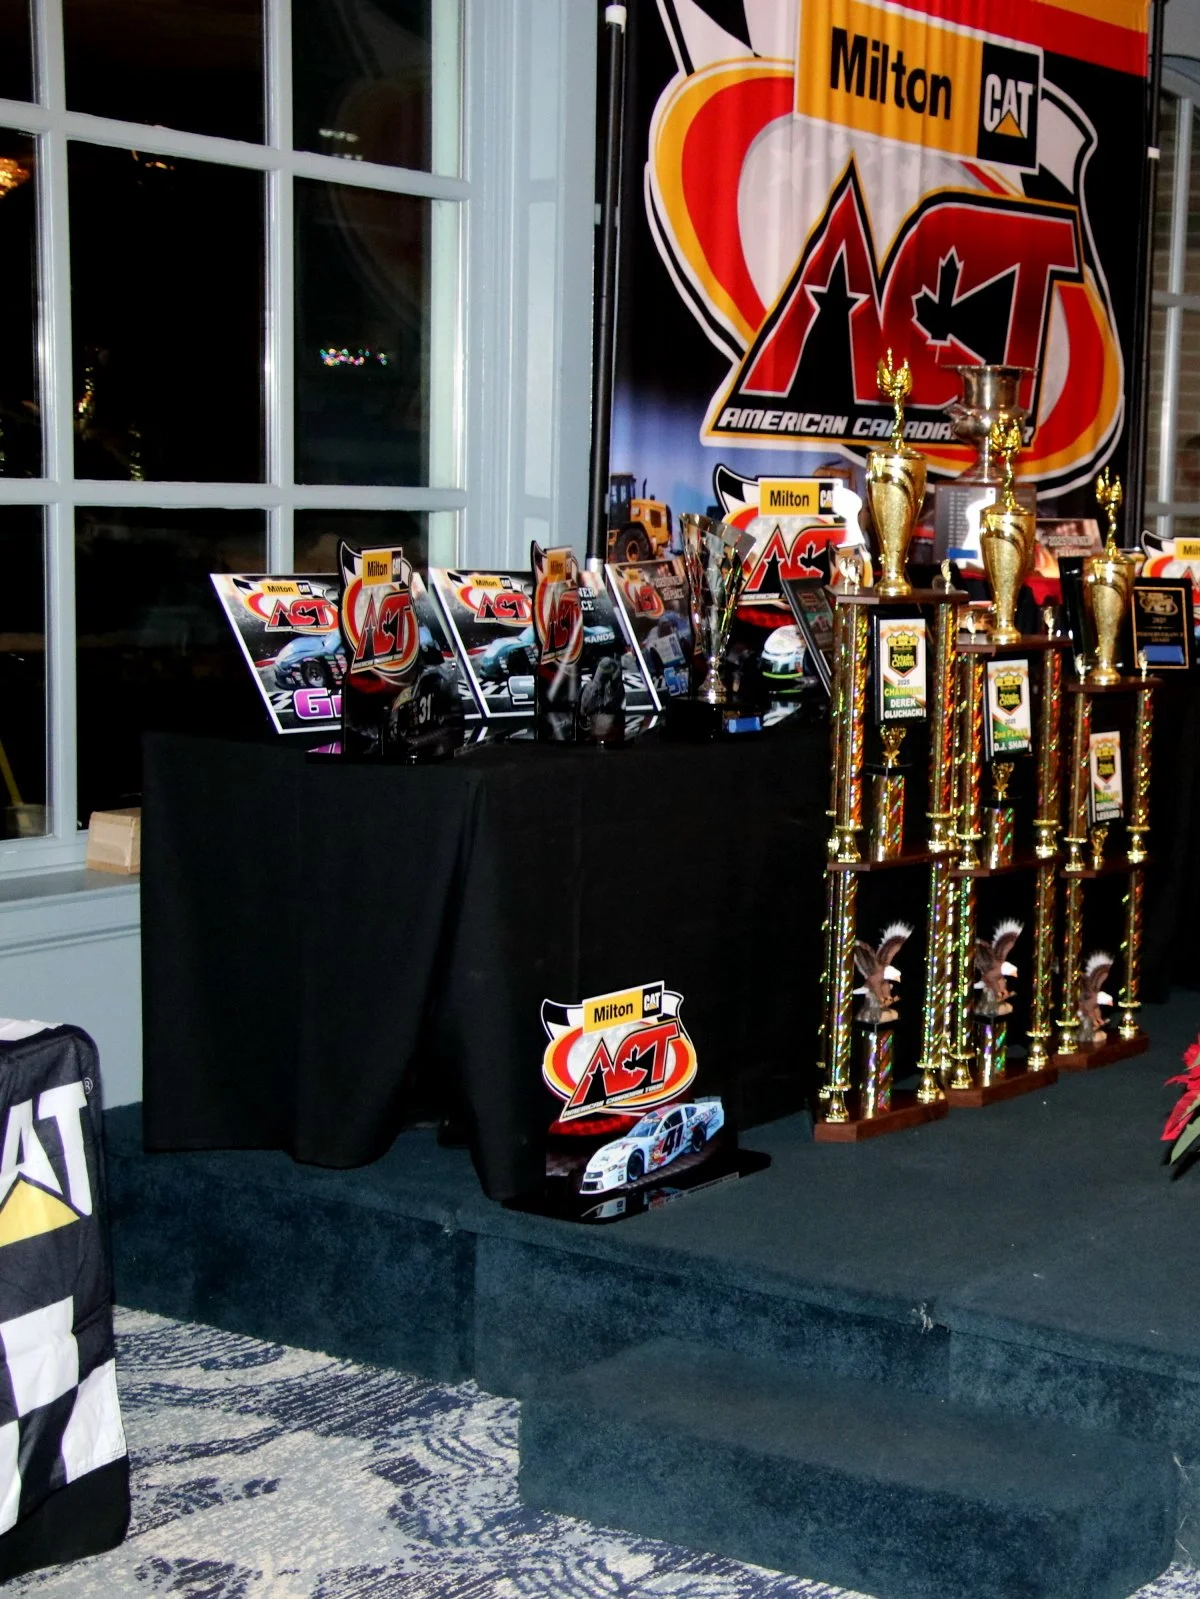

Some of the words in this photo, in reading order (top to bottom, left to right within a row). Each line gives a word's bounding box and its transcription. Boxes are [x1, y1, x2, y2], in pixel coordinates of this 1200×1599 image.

[829, 27, 953, 121] Milton
[983, 73, 1034, 139] CAT
[738, 178, 1079, 409] ACT
[717, 407, 849, 436] AMERICAN
[852, 417, 958, 441] CAADIA
[769, 489, 810, 508] Milton
[819, 489, 833, 508] CA
[367, 561, 388, 577] Milton
[741, 528, 850, 593] AC
[267, 585, 294, 594] Milton
[475, 579, 497, 588] Milton
[267, 598, 331, 627] ACT
[476, 592, 527, 619] ACT
[355, 592, 411, 660] ACT
[418, 693, 432, 724] 31
[890, 697, 917, 709] DEREK
[993, 741, 1008, 752] D.J.
[1008, 739, 1029, 750] SHAW
[593, 1002, 634, 1024] Milton
[643, 992, 661, 1013] CAT
[567, 1019, 681, 1109] ACT
[563, 1099, 605, 1118] AMERICAN
[605, 1088, 644, 1106] CANADIAN
[644, 1082, 664, 1094] TOUR
[0, 1080, 93, 1217] AT
[660, 1123, 684, 1157] 41
